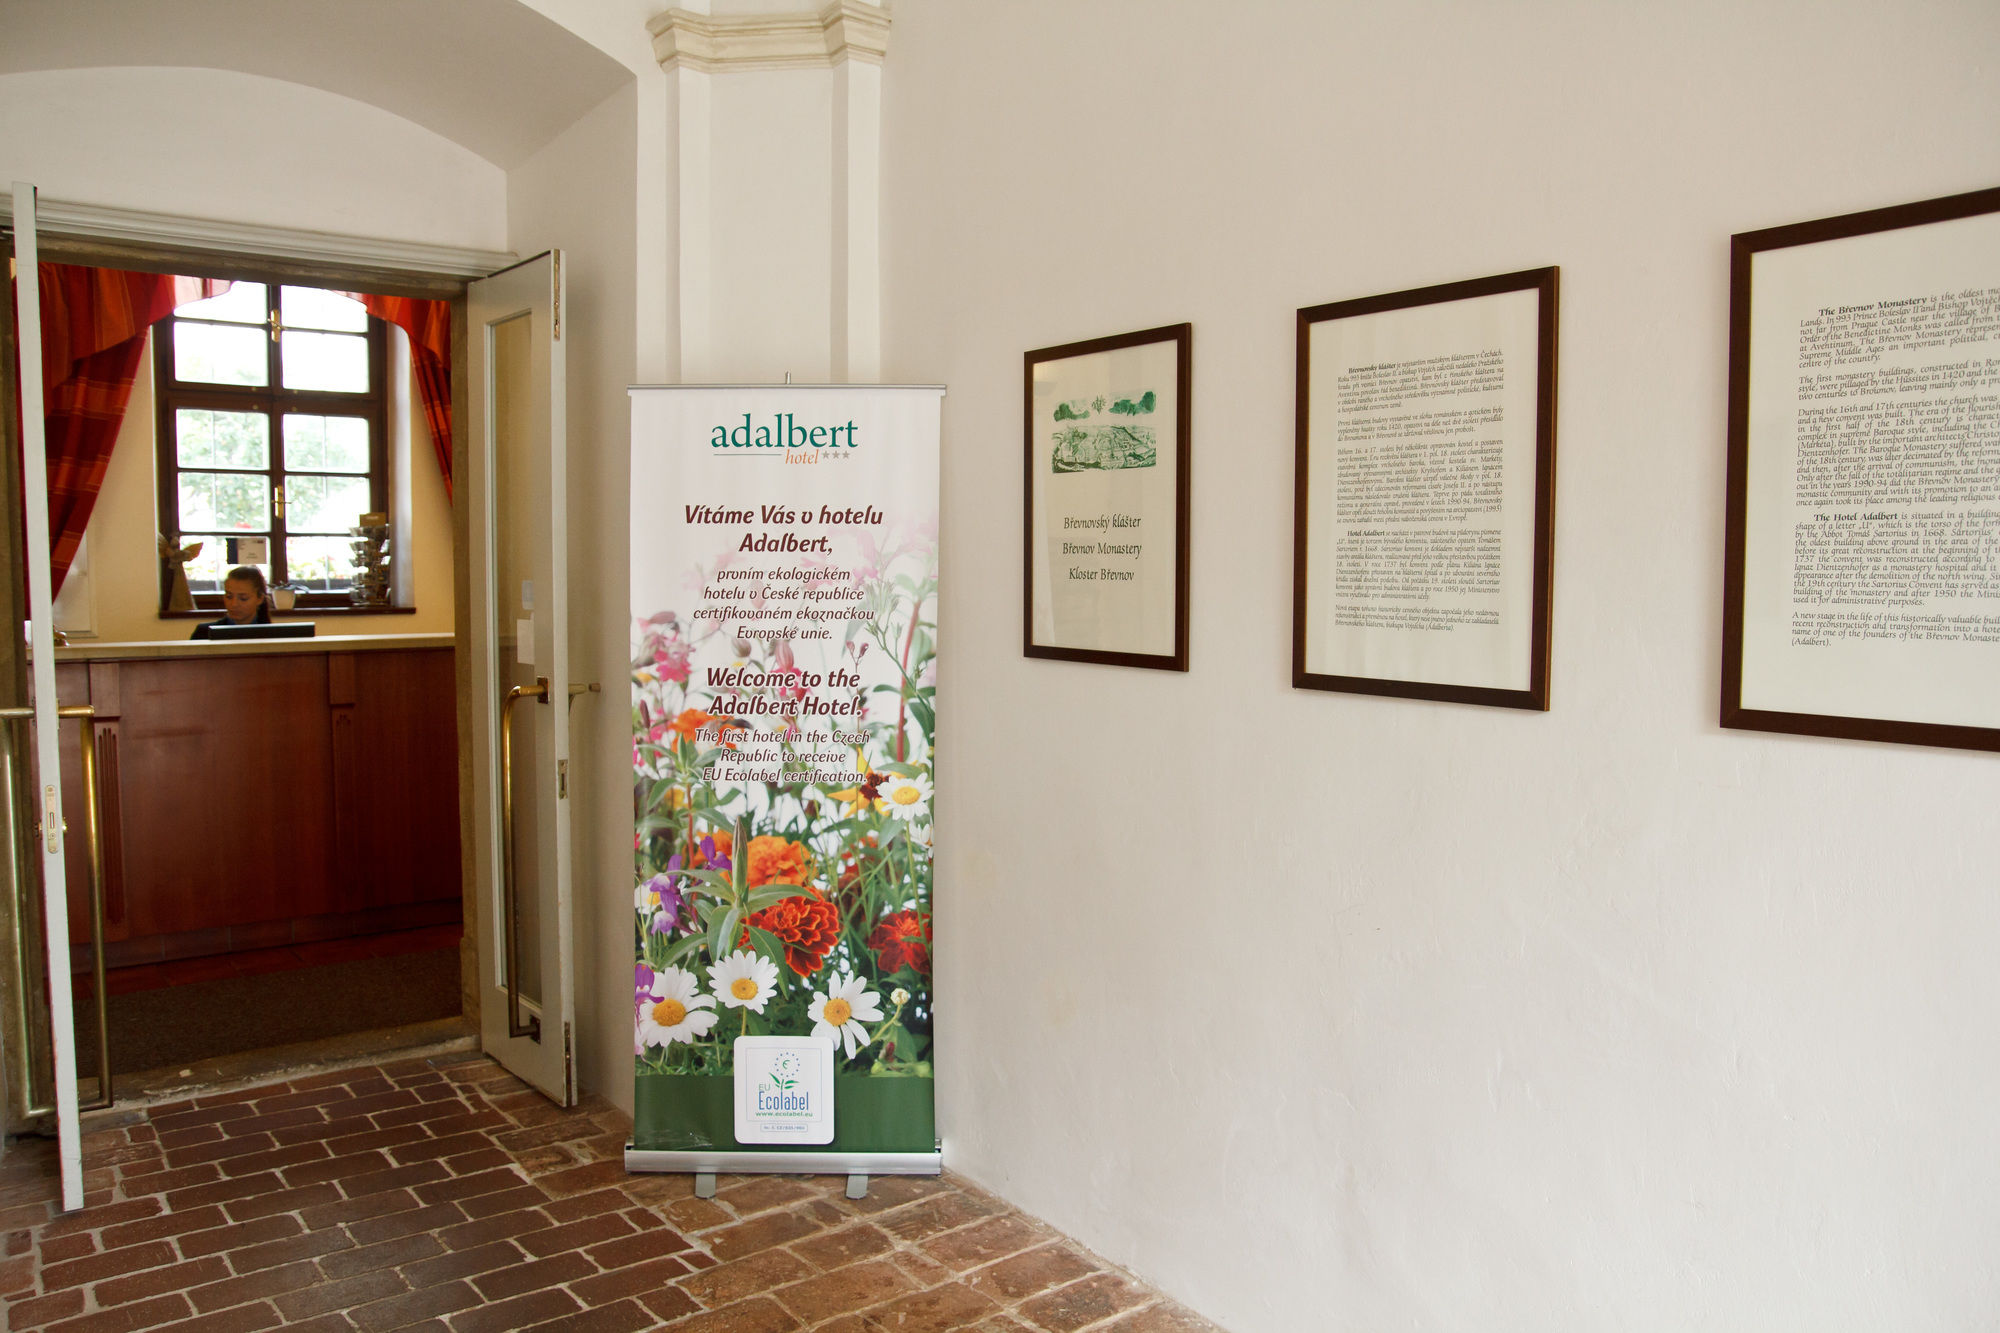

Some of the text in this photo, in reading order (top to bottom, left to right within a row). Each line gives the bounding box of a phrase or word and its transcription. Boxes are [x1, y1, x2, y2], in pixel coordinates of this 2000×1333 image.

[1818, 308, 1835, 316] The
[1878, 298, 1927, 309] Monastery
[1941, 292, 1955, 301] the
[1958, 289, 1983, 299] oldest
[1800, 318, 1824, 327] Lands.
[1836, 314, 1851, 323] 993
[1853, 313, 1877, 321] Prince
[1879, 307, 1911, 318] Boleslav
[1921, 303, 1936, 313] and
[1938, 301, 1968, 311] Bishop
[1816, 326, 1827, 336] far
[1830, 324, 1847, 334] from
[1852, 321, 1878, 330] Prague
[1882, 316, 1906, 326] Castle
[1911, 315, 1928, 323] near
[1933, 311, 1945, 320] the
[1950, 309, 1977, 319] village
[1800, 335, 1821, 344] Order
[1830, 332, 1842, 340] the
[1844, 328, 1891, 339] Benedictine
[1893, 323, 1921, 333] Monks
[1925, 322, 1942, 330] was
[1944, 317, 1969, 327] called
[1973, 316, 1993, 327] from
[1810, 341, 1855, 351] Aventinum.
[1860, 337, 1875, 345] The
[1916, 329, 1962, 339] Monastery
[1799, 352, 1831, 362] Supreme
[1836, 347, 1861, 356] Middle
[1865, 345, 1885, 355] Ages
[1903, 338, 1945, 351] important
[1950, 333, 1988, 347] political,
[1799, 360, 1821, 368] centre
[1834, 357, 1847, 365] the
[1849, 355, 1881, 363] country.
[1798, 384, 1818, 394] style,
[1840, 379, 1869, 391] pillaged
[1881, 377, 1893, 385] the
[1896, 375, 1930, 384] Hussites
[1942, 370, 1965, 380] 1420
[1967, 369, 1982, 378] and
[1984, 368, 1998, 376] the
[1799, 376, 1813, 384] The
[1817, 375, 1832, 385] first
[1836, 372, 1875, 381] monastery
[1879, 367, 1917, 377] buildings,
[1921, 361, 1968, 373] constructed
[1815, 391, 1847, 399] centuries
[1860, 387, 1896, 395] Broumov,
[1899, 384, 1927, 393] leaving
[1930, 380, 1958, 391] mainly
[1960, 378, 1978, 389] only
[1798, 409, 1824, 417] During
[1826, 406, 1838, 414] the
[1840, 404, 1858, 413] 16th
[1860, 403, 1873, 412] and
[1876, 401, 1895, 410] 17th
[1896, 400, 1932, 409] centuries
[1935, 397, 1948, 406] the
[1950, 395, 1978, 405] church
[711, 413, 858, 448] adalbert
[785, 449, 819, 464] hotel
[685, 505, 883, 524] Vítáme Vás v hotelu
[1063, 513, 1141, 533] Břevnovský klášter
[1813, 513, 1830, 521] The
[1834, 513, 1857, 521] Hotel
[1861, 512, 1898, 520] Adalbert
[1911, 510, 1943, 519] situated
[1947, 511, 1955, 519] in
[739, 532, 833, 555] Adalbert,
[1063, 542, 1142, 560] Břevnov Monastery
[717, 567, 850, 583] prvním ekologickém
[1069, 566, 1134, 581] Kloster Břevnov
[703, 584, 864, 602] hotelu v České republice
[693, 606, 874, 622] certifikovaném ekoznačkou
[1817, 613, 1836, 622] stage
[1847, 612, 1859, 620] the
[1860, 612, 1872, 623] life
[1884, 613, 1899, 621] this
[1901, 613, 1946, 626] historically
[1948, 615, 1981, 624] valuable
[737, 626, 832, 642] Evropské unie.
[1792, 637, 1831, 648] (Adalbert).
[707, 667, 860, 687] Welcome to the
[709, 696, 862, 716] Adalbert Hotel.
[695, 729, 870, 745] The first hotel in the Czech
[720, 749, 846, 764] Republic to receive
[702, 768, 867, 785] EU Ecolabel certification.
[759, 1091, 809, 1111] Ecolabel
